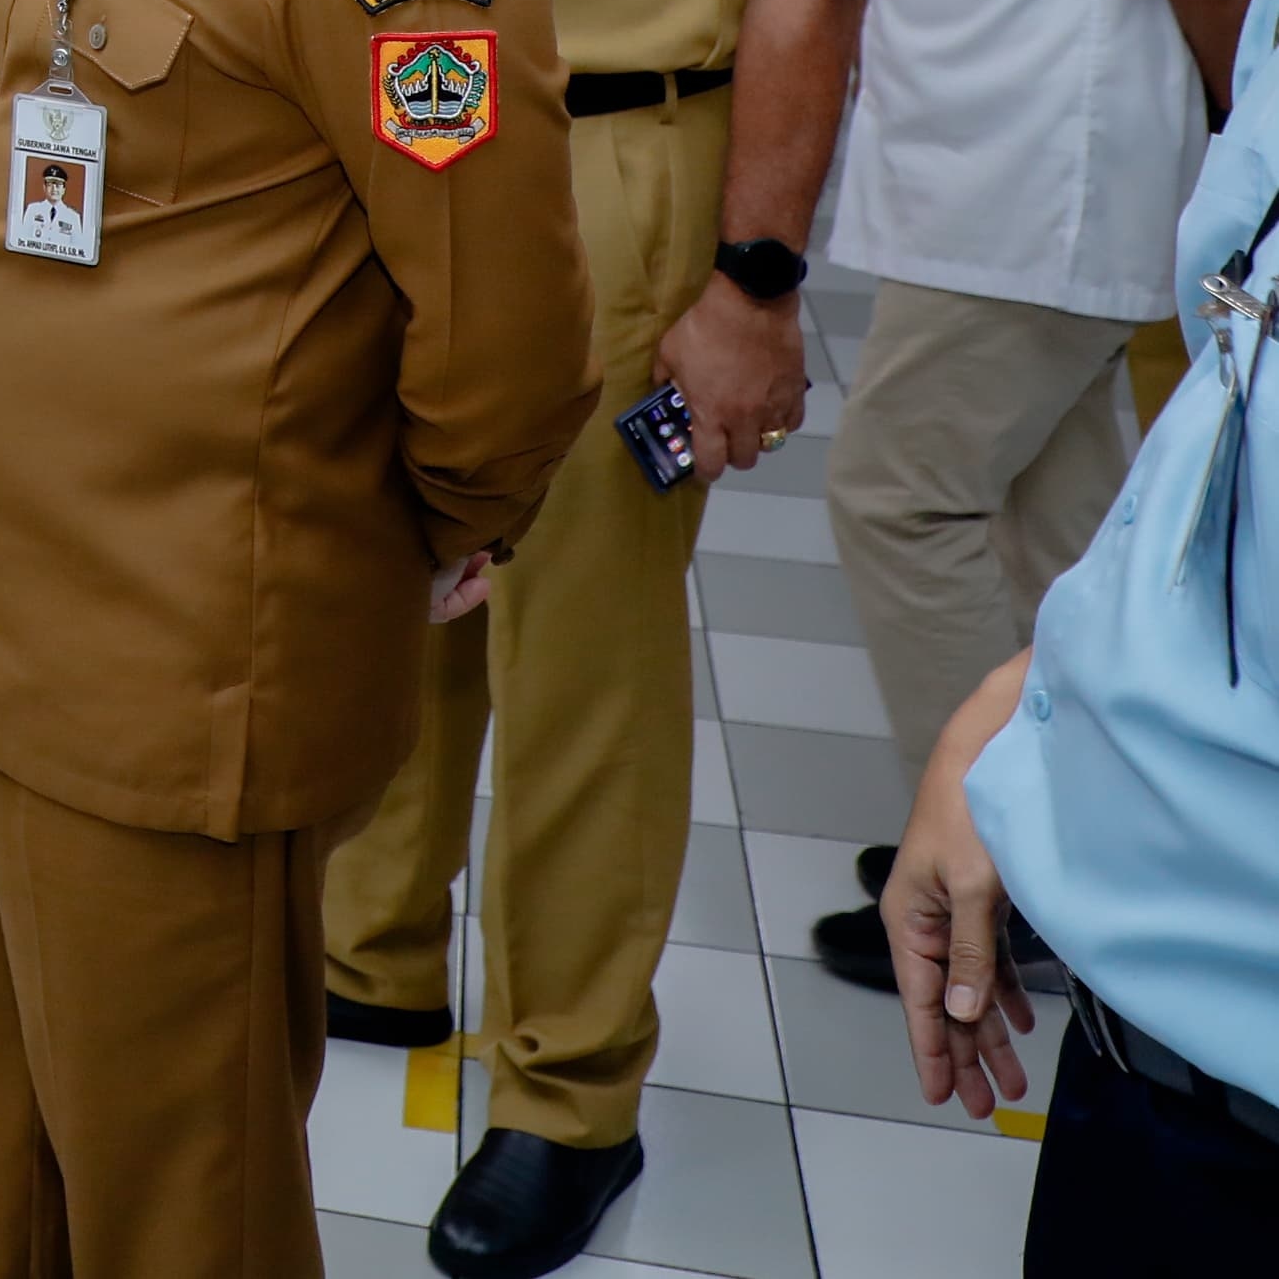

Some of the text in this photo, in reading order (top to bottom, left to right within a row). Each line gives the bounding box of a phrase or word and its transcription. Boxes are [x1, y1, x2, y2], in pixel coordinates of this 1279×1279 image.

[17, 137, 97, 158] GUBERNUR JAWA TENGAH
